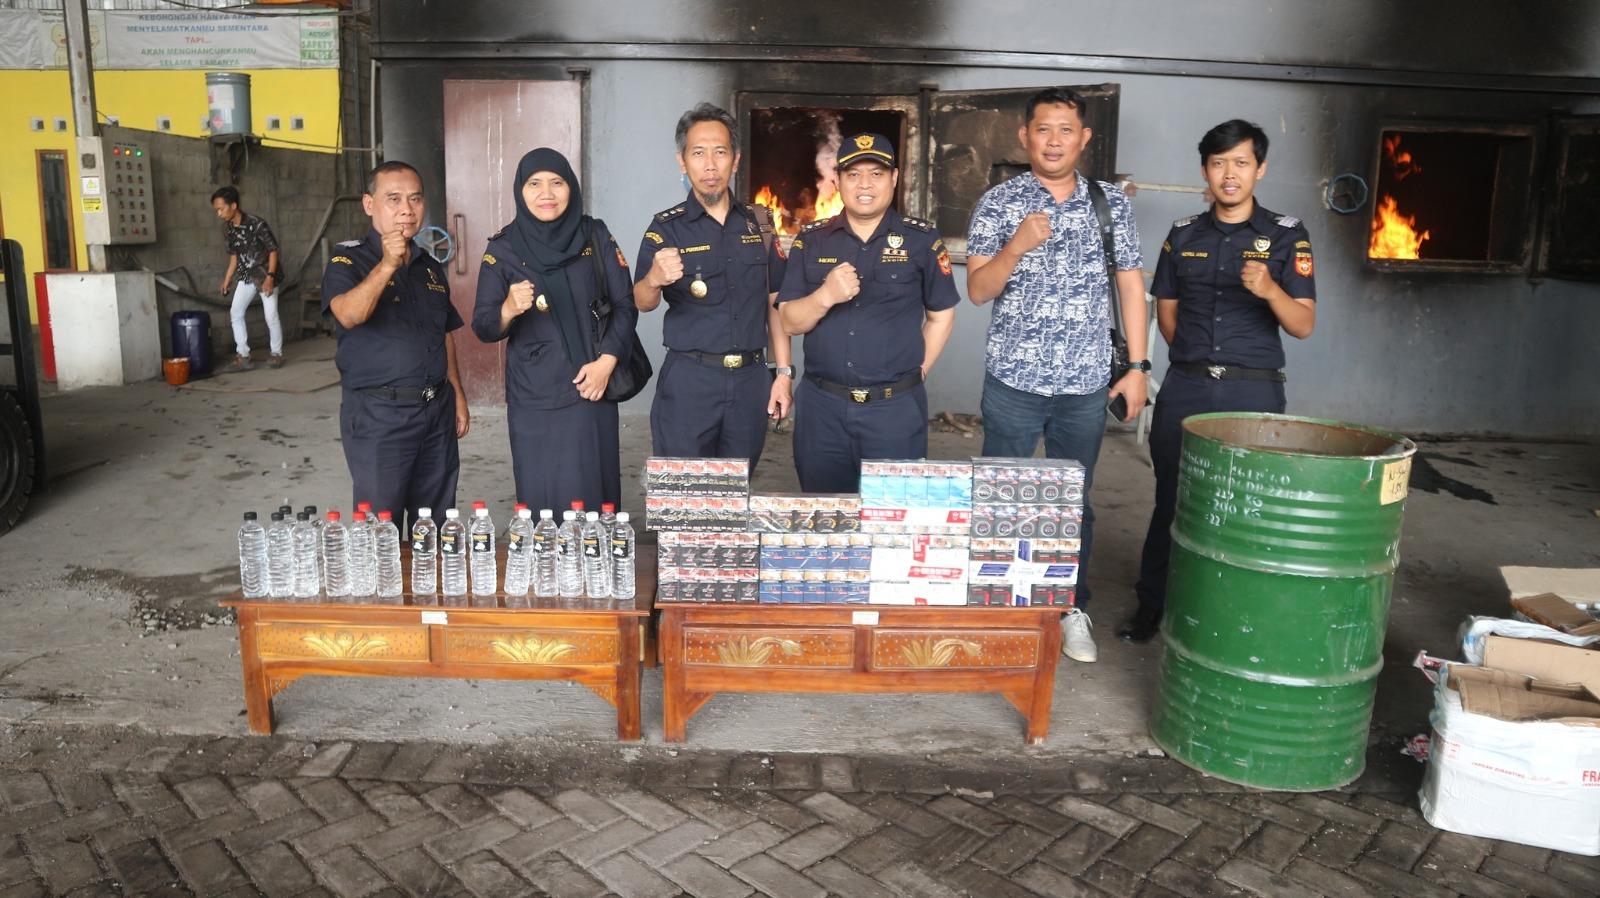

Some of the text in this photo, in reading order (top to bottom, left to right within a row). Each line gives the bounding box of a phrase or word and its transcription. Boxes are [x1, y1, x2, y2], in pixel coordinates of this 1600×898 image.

[127, 25, 269, 33] MENYELAMATKANMU SEMENTARA
[166, 47, 257, 55] MENGHANCURKANMU
